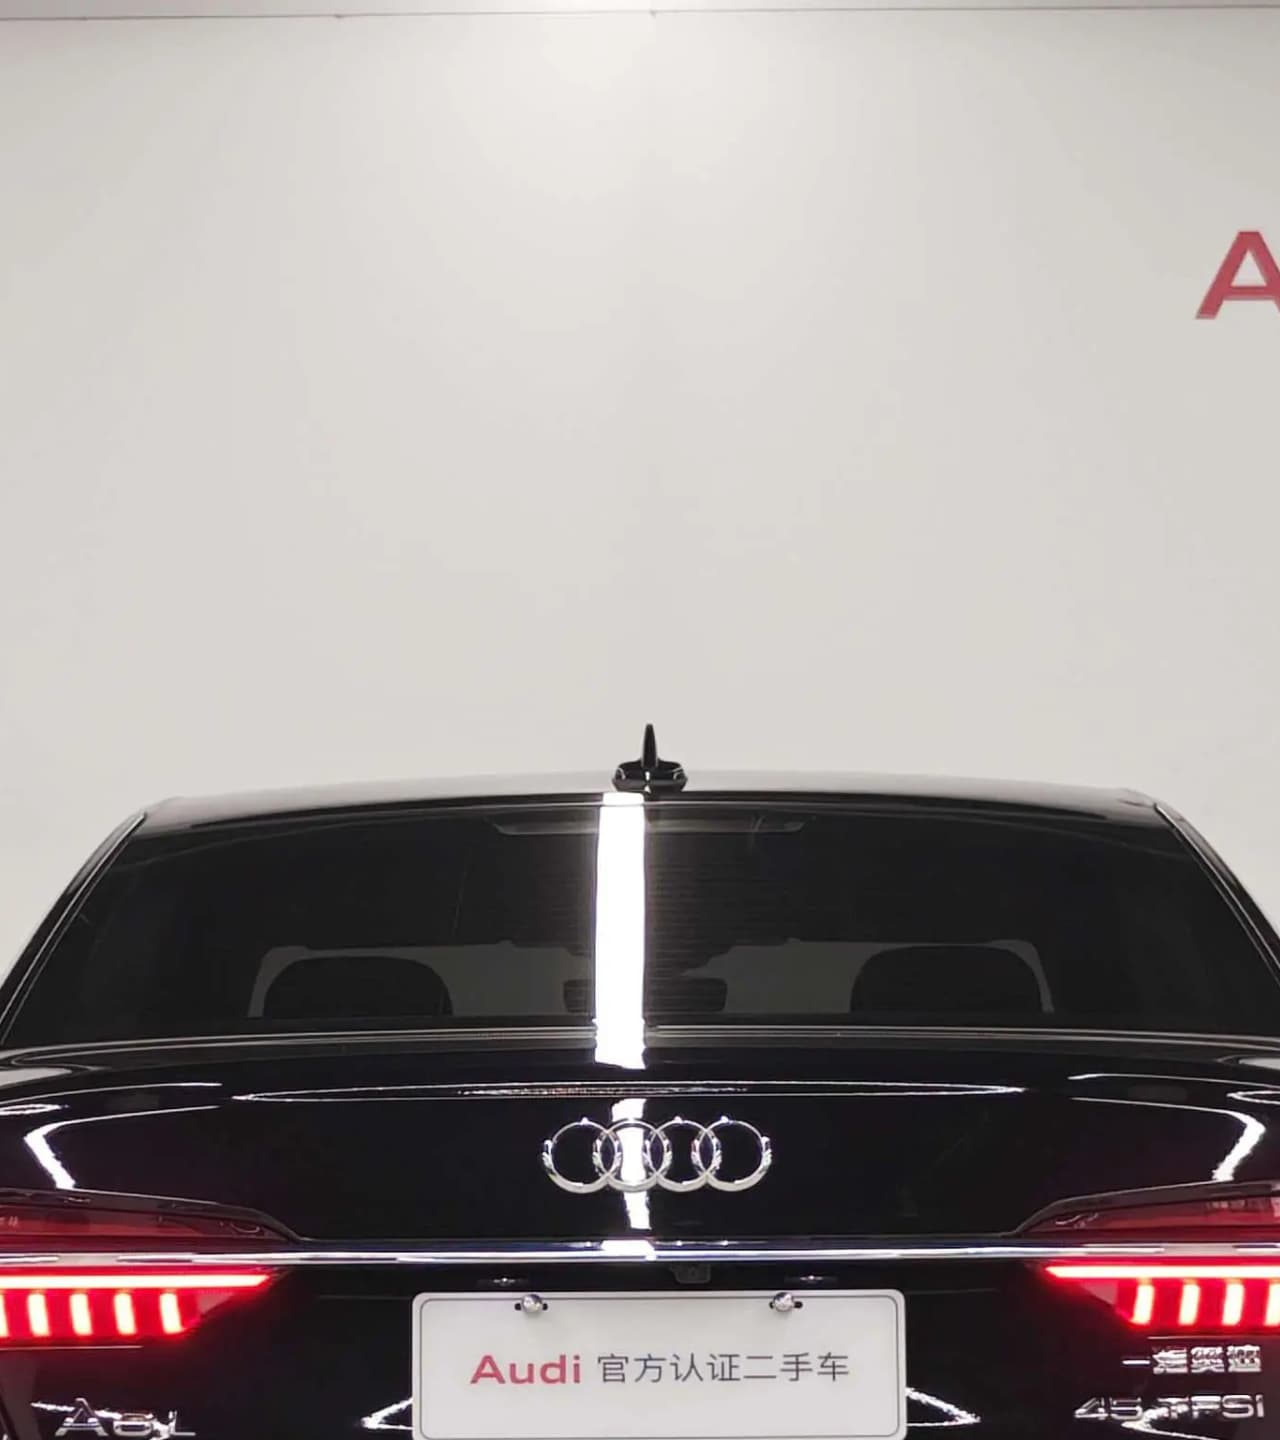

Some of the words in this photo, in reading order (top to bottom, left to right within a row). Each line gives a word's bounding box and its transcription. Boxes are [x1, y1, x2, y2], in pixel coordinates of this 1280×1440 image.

[470, 1354, 581, 1385] Audi
[597, 1351, 849, 1383] 官方认证二手车
[55, 1397, 197, 1437] A6L
[1074, 1396, 1144, 1420] 45
